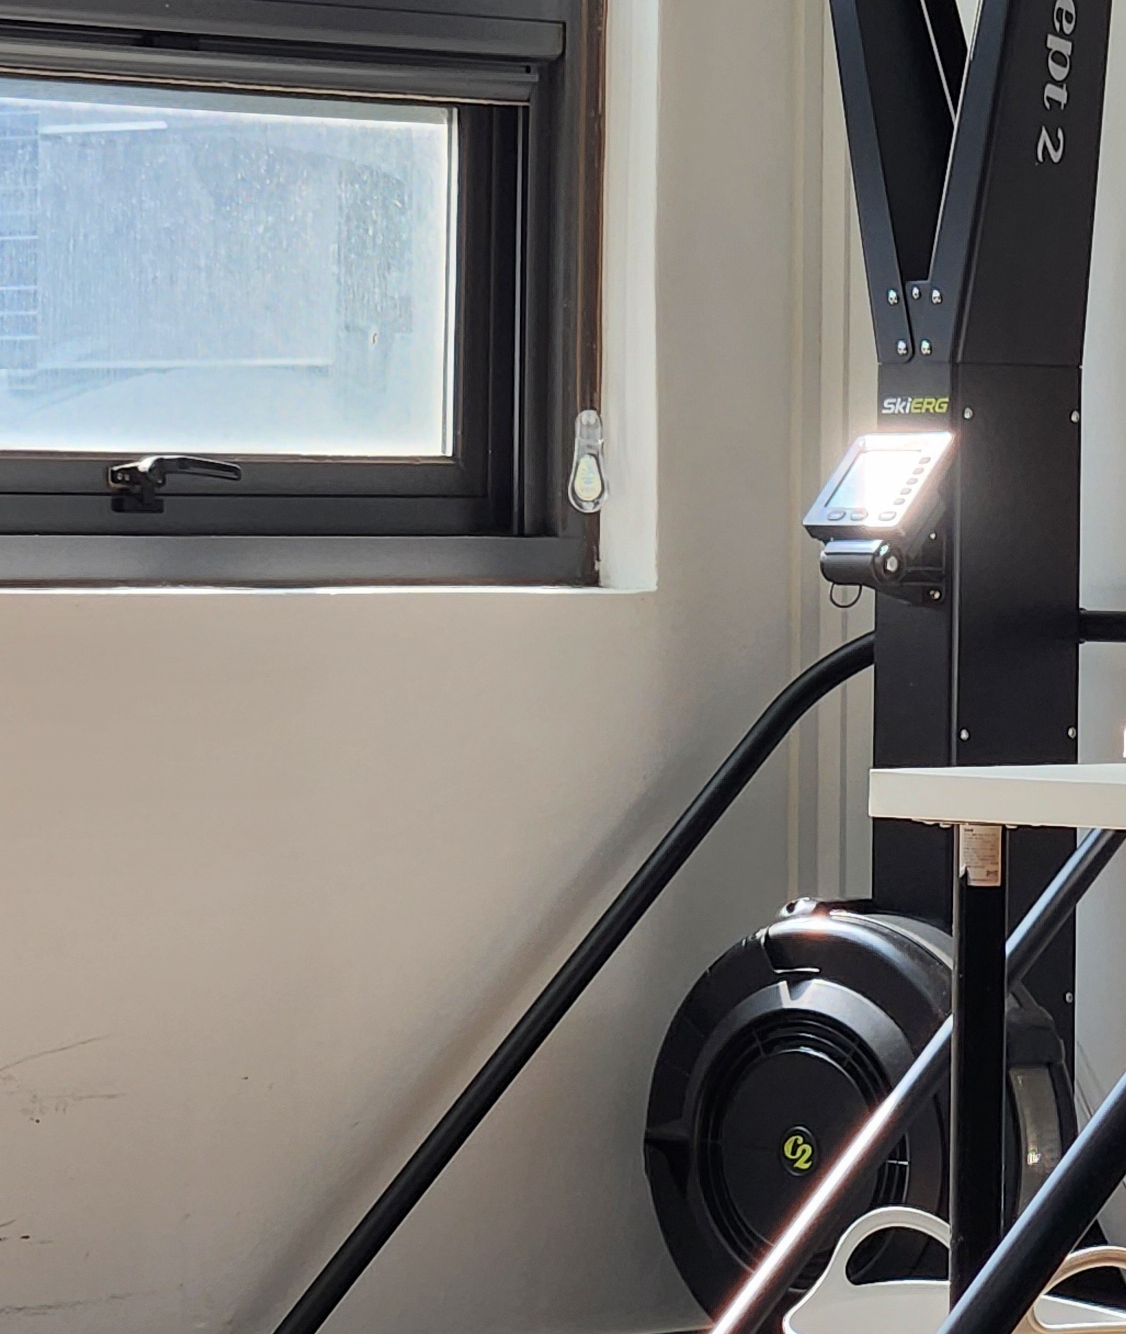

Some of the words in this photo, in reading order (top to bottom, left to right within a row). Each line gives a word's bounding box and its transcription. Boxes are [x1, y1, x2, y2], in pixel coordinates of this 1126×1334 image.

[1037, 125, 1064, 164] 2
[881, 396, 950, 415] SkiERG
[784, 1135, 813, 1170] C2
